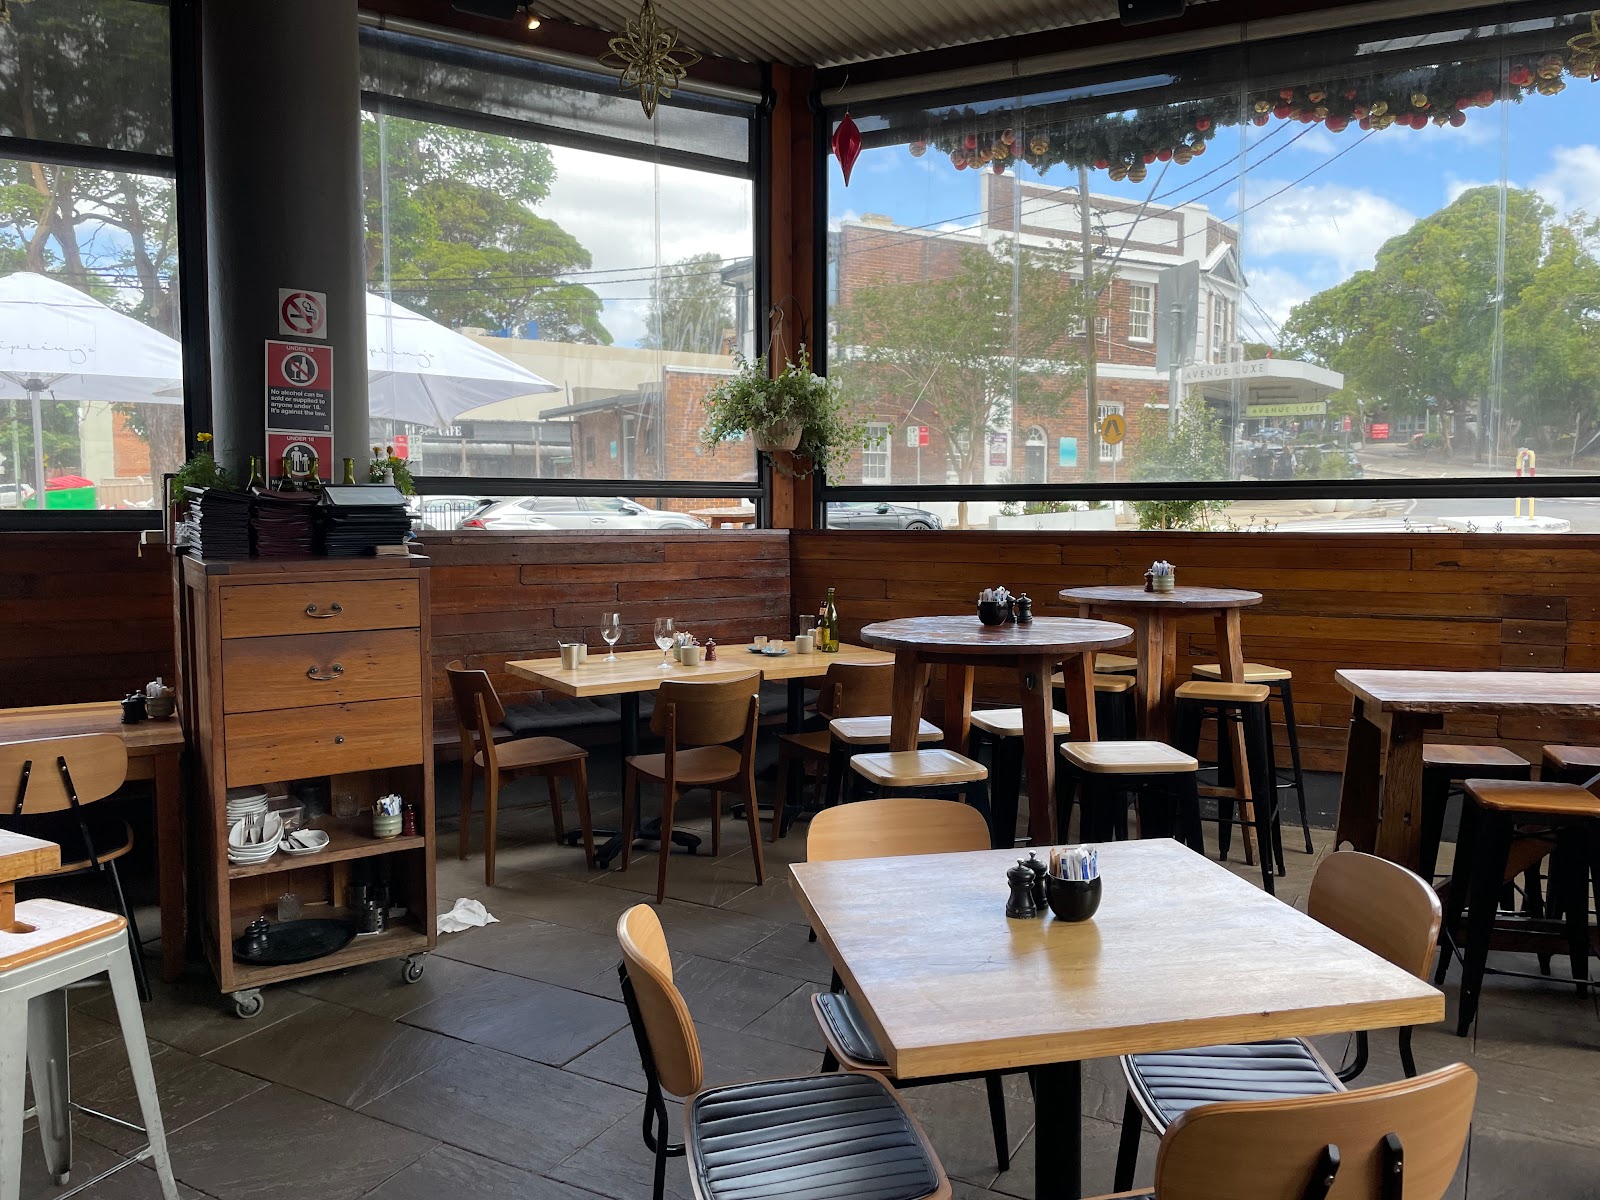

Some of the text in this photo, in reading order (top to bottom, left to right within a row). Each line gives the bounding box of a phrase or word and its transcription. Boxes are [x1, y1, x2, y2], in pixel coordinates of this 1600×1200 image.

[0, 340, 95, 365] ipling's
[1186, 363, 1264, 380] AVENUE LUXE
[1252, 404, 1321, 414] AVENUE LUXE
